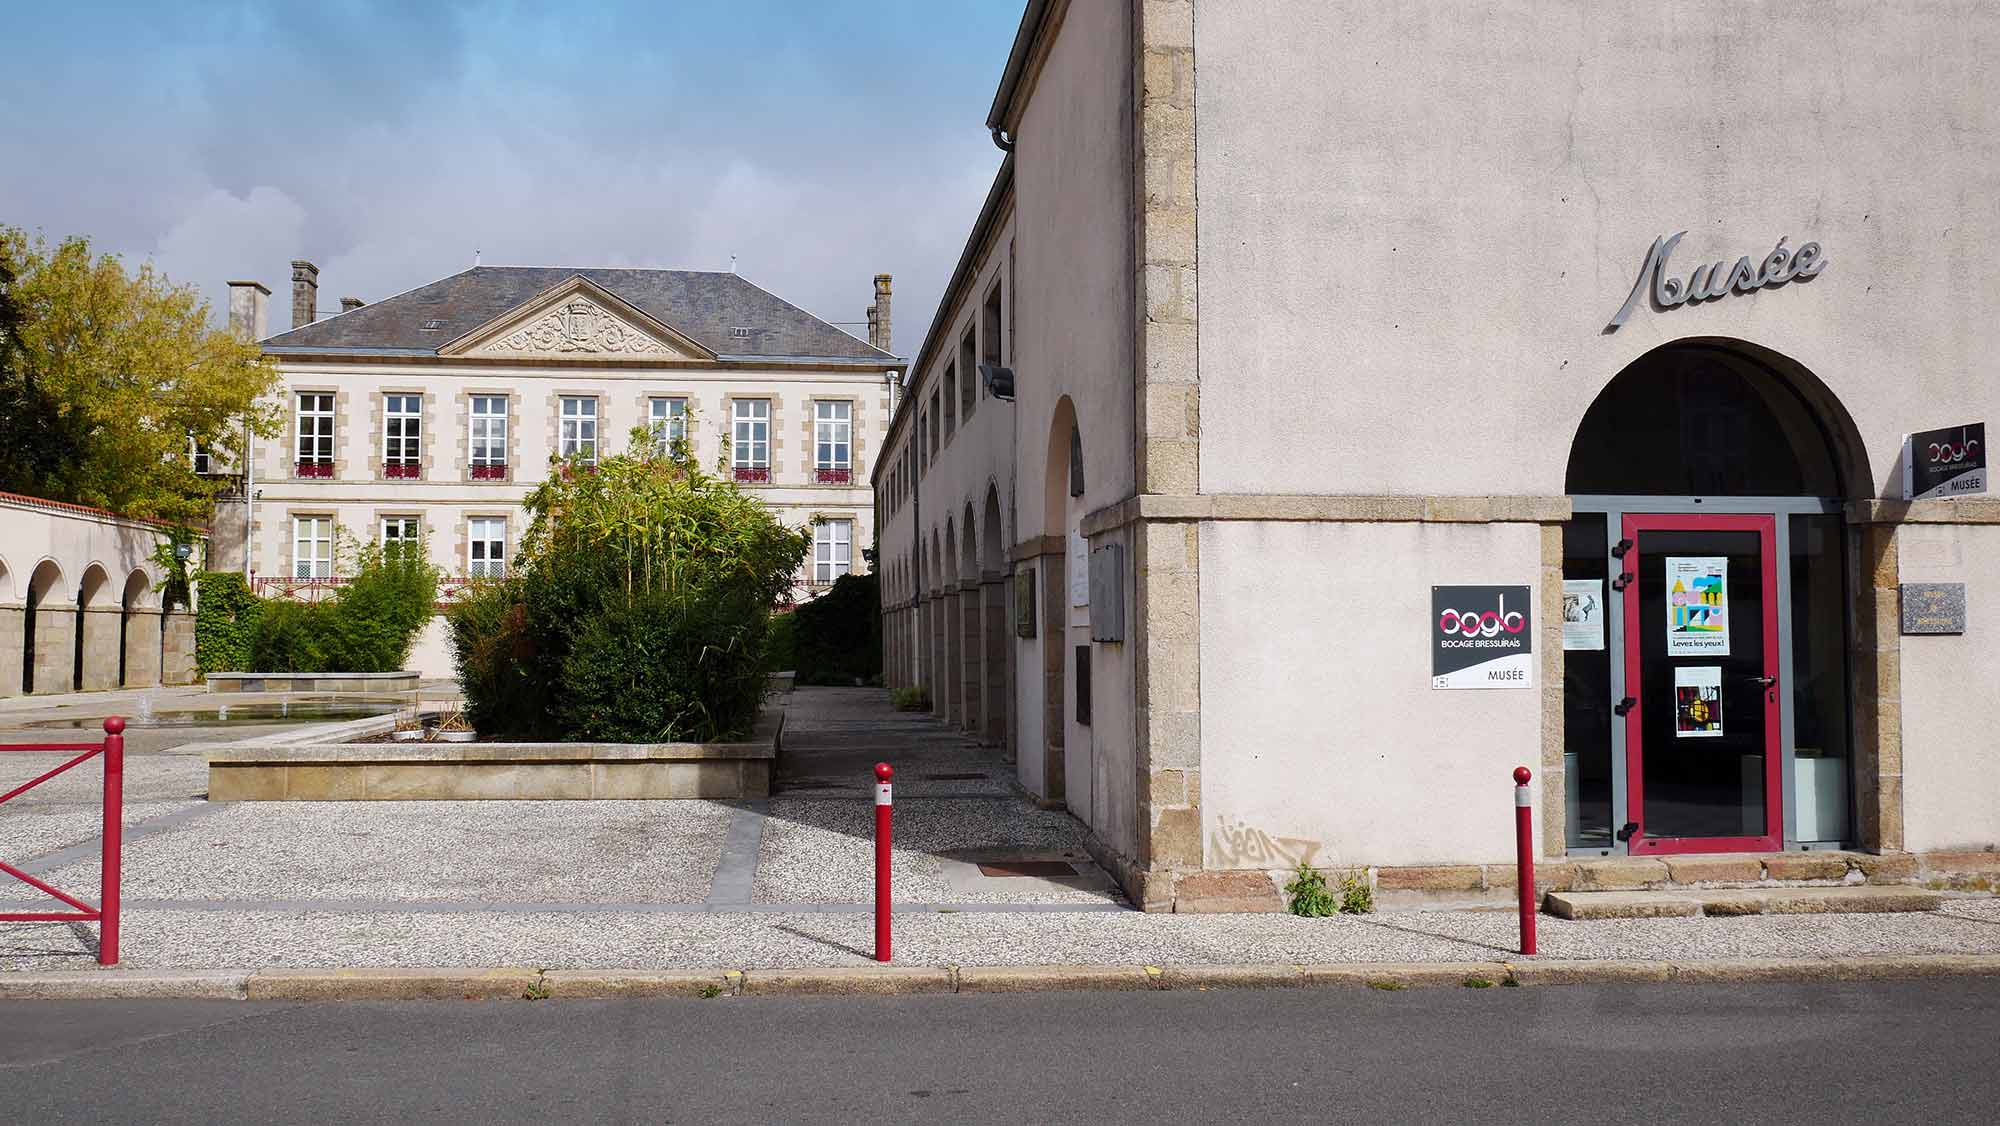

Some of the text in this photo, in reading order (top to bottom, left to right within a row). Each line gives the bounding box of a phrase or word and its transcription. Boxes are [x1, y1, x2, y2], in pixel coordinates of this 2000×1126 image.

[1602, 231, 1828, 335] Musée
[1951, 476, 1980, 491] MUSÉE
[1441, 640, 1474, 648] BOCAGE
[1488, 667, 1524, 680] MUSÉE
